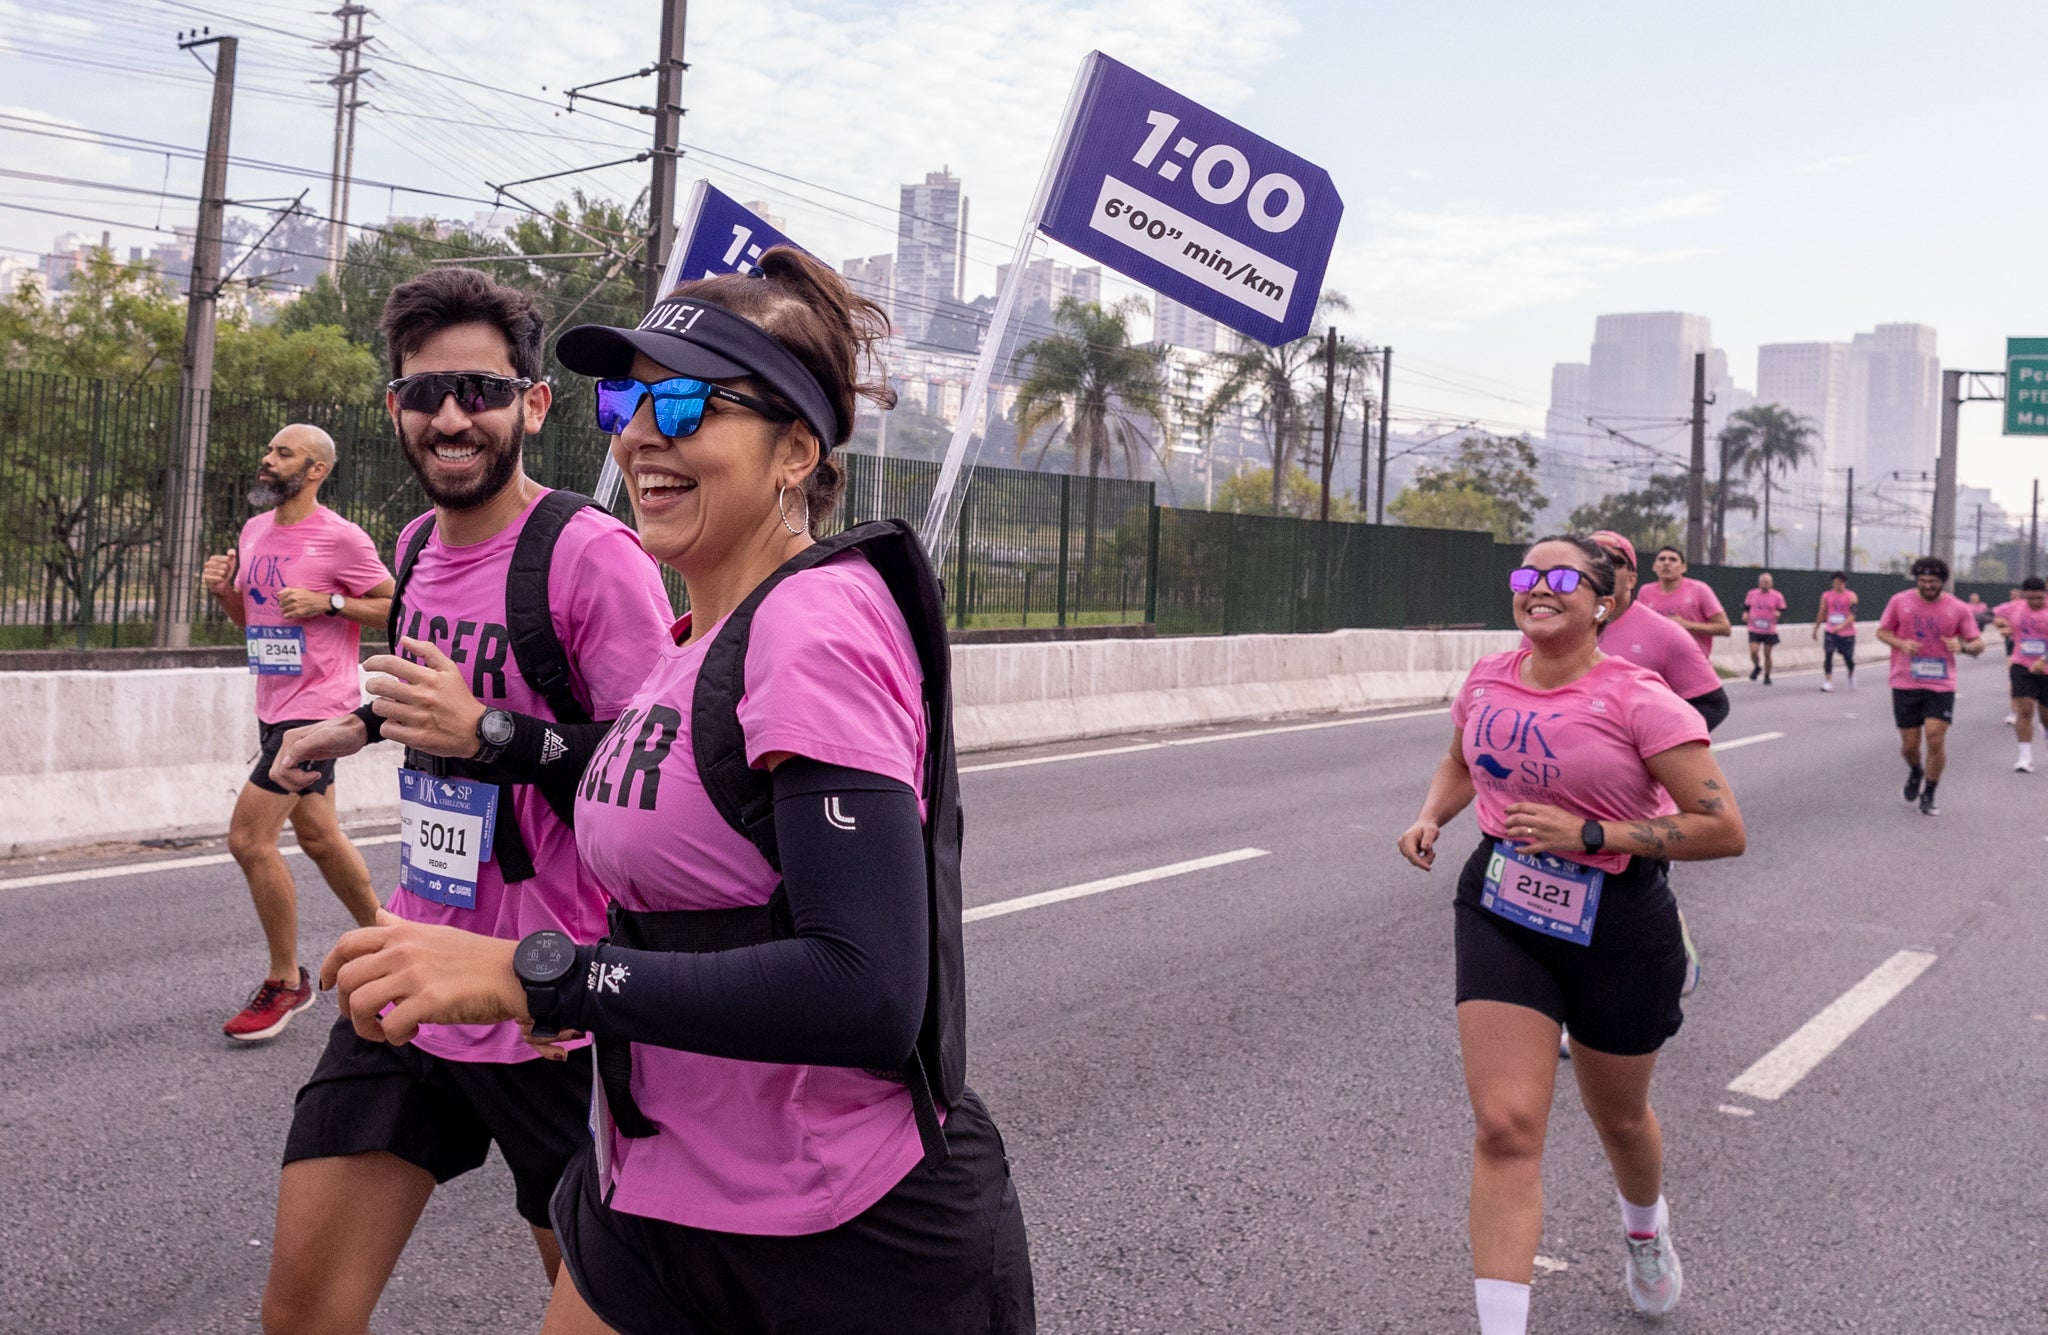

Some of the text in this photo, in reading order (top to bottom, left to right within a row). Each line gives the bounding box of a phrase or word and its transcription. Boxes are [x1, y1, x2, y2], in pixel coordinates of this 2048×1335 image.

[1132, 110, 1305, 233] 1:00
[722, 224, 763, 276] 1:
[1182, 240, 1285, 302] min/km
[2017, 411, 2048, 426] Ma
[265, 644, 297, 655] 2344
[1474, 704, 1564, 760] 10K
[578, 704, 681, 810] CER
[1521, 760, 1560, 788] SP
[457, 785, 473, 801] SP
[420, 820, 467, 857] 5011
[428, 859, 448, 870] PEDRO
[1516, 875, 1570, 908] 2121
[587, 961, 600, 991] UV 50+
